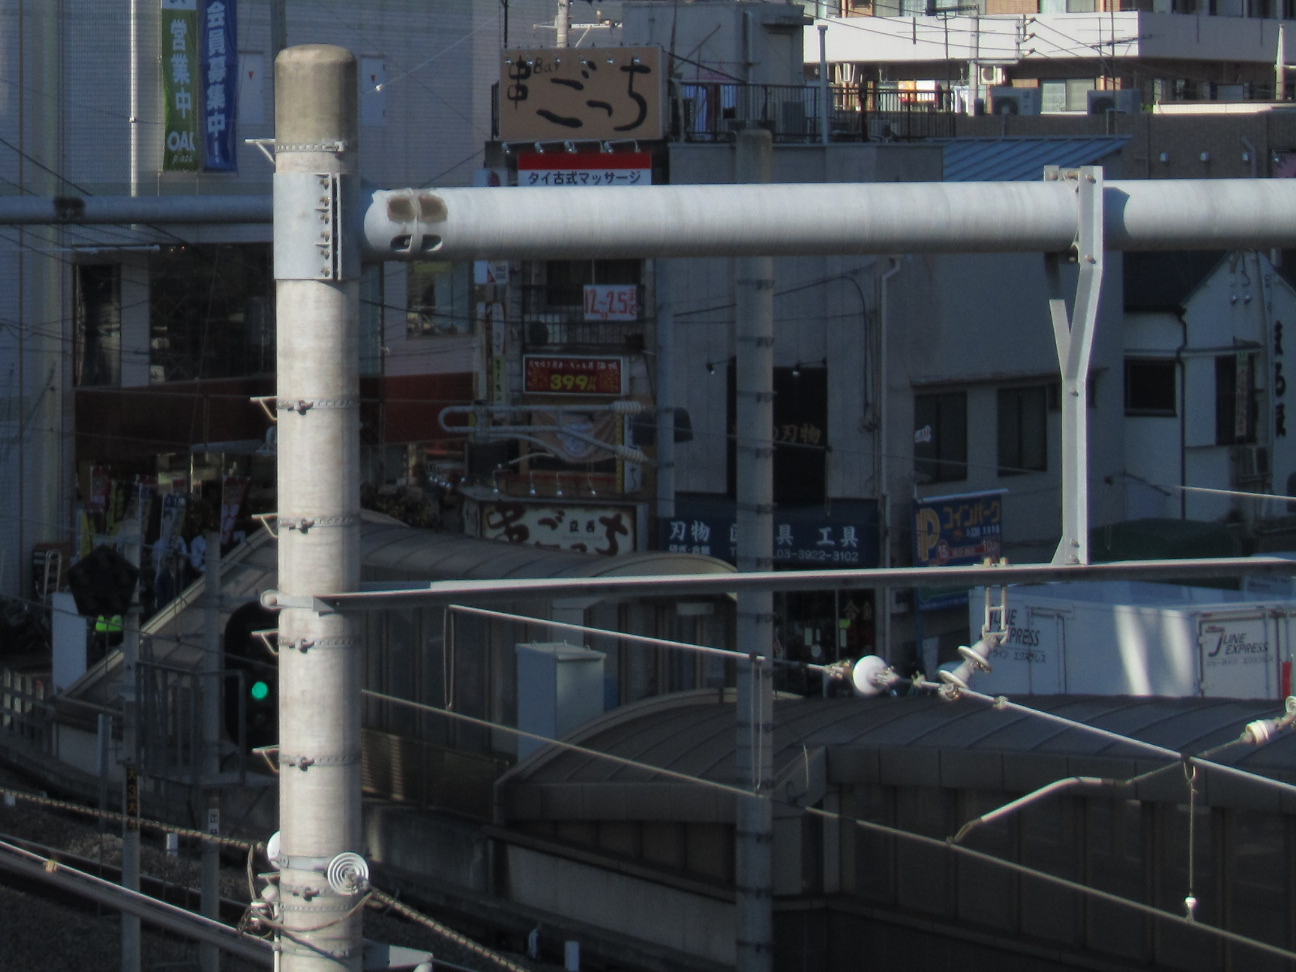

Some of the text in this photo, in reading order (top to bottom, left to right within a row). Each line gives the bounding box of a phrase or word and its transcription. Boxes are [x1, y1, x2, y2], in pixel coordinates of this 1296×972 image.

[170, 18, 191, 118] 営業中
[167, 131, 195, 151] OAK
[528, 170, 641, 185] タイ古式マッサージ
[669, 520, 710, 542] 刃物
[816, 525, 859, 547] 工具
